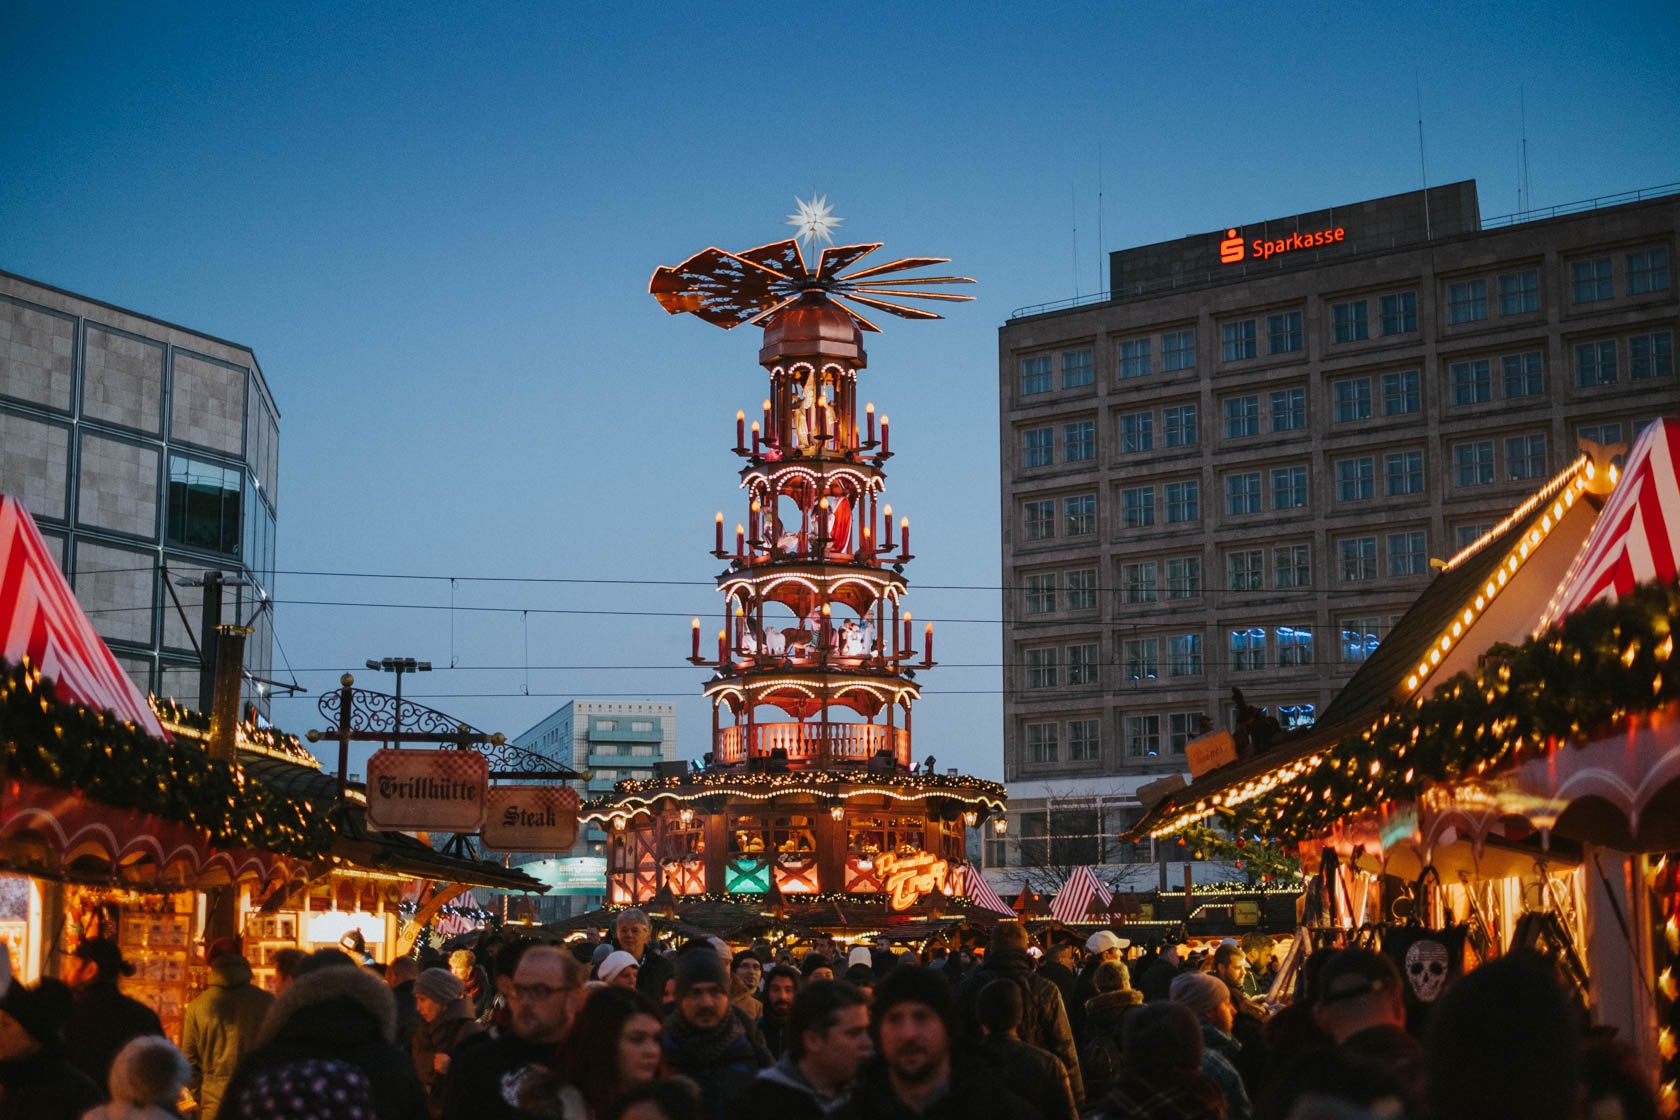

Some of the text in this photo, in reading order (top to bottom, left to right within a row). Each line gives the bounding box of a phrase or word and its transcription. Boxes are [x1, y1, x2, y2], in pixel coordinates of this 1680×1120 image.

[1252, 227, 1345, 260] Sparkasse
[377, 775, 476, 801] Grillhütte
[502, 805, 557, 828] Steak
[887, 860, 946, 909] Treff
